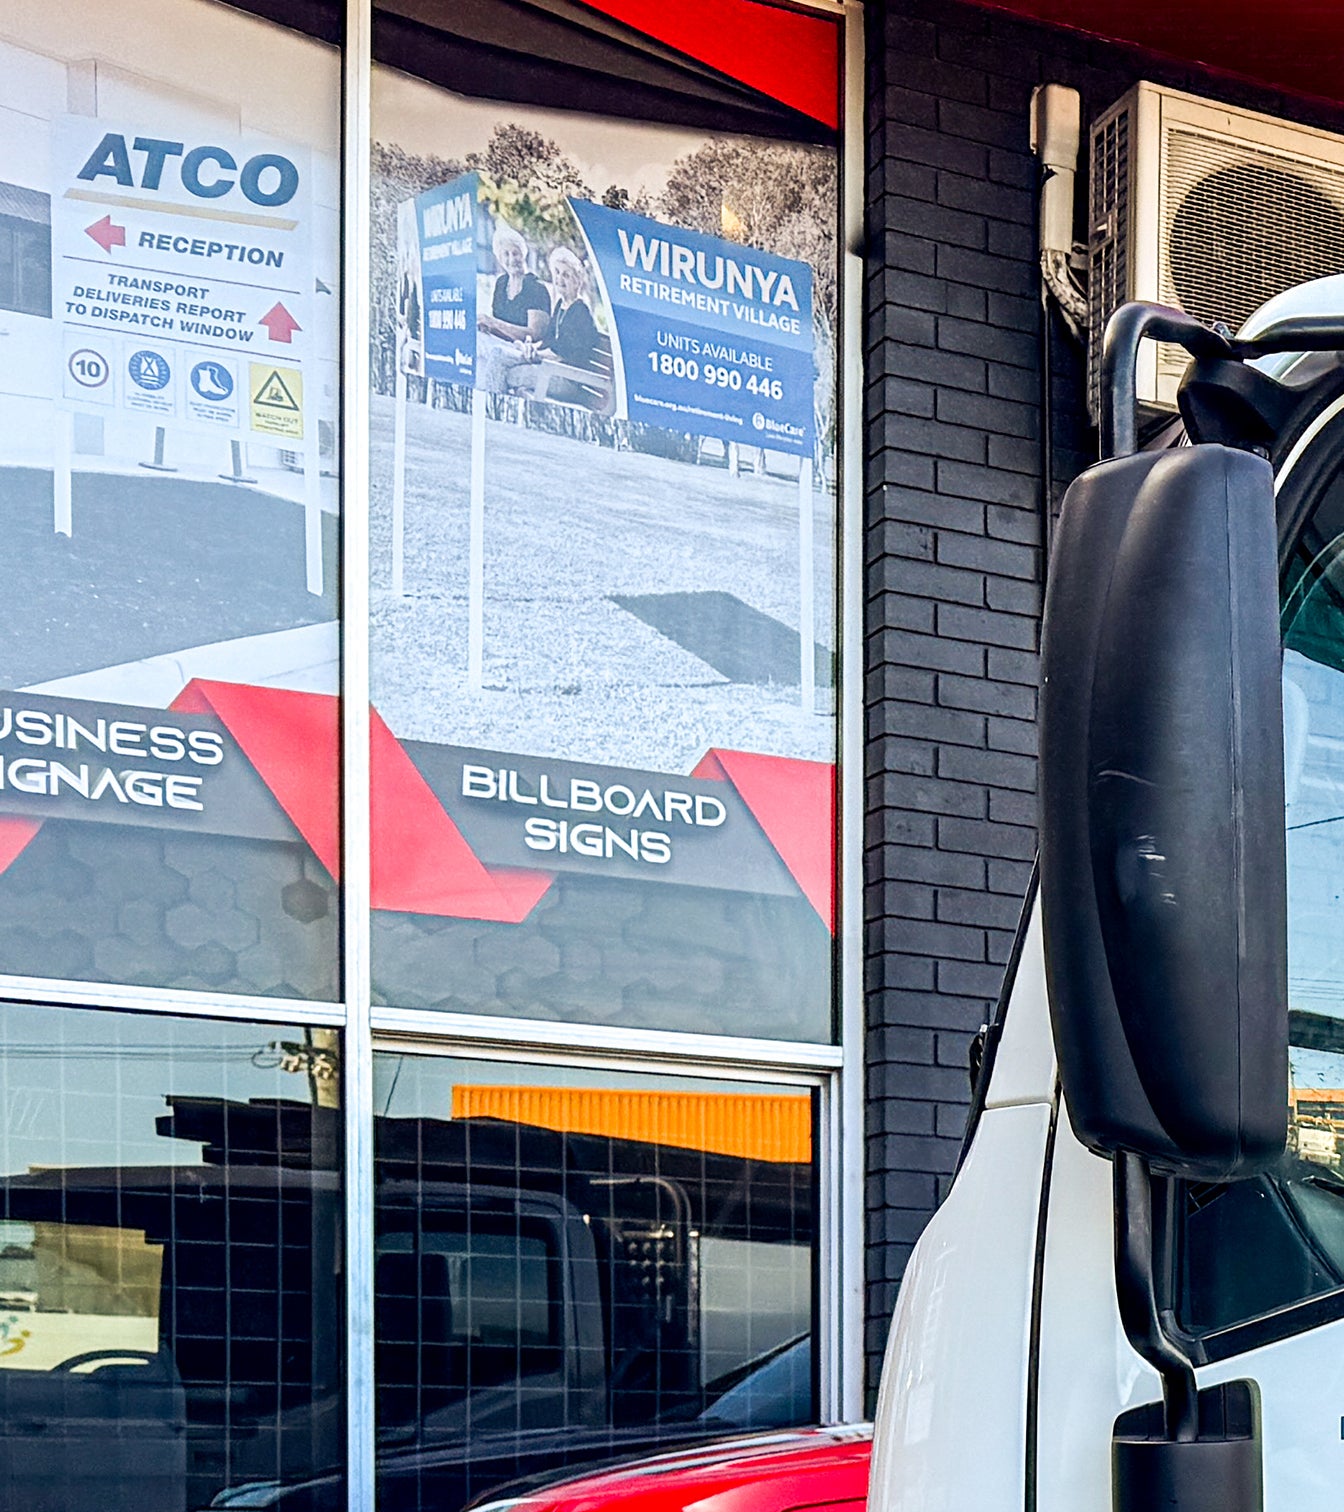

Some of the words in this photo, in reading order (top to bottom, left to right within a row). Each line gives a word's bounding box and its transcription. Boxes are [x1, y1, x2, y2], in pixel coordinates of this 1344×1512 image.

[77, 132, 299, 207] ATCO
[138, 231, 284, 268] RECEPTION
[617, 228, 800, 311] WIRUNYA
[73, 286, 171, 312] DELIVERIES
[176, 302, 247, 323] REPORT
[108, 273, 210, 300] TRANSPORT
[620, 274, 730, 317] RETIREMENT
[733, 303, 801, 335] VILLAGE
[65, 302, 87, 315] TO
[91, 306, 174, 330] DISPATCH
[180, 320, 254, 343] WINDOW
[76, 359, 101, 378] 10
[656, 331, 700, 354] UNITS
[702, 343, 774, 372] AVAILABLE
[648, 351, 699, 380] 1800
[704, 364, 742, 390] 990
[746, 376, 783, 400] 446
[462, 764, 727, 827] BILLBOARD
[524, 817, 672, 864] SIGNS
